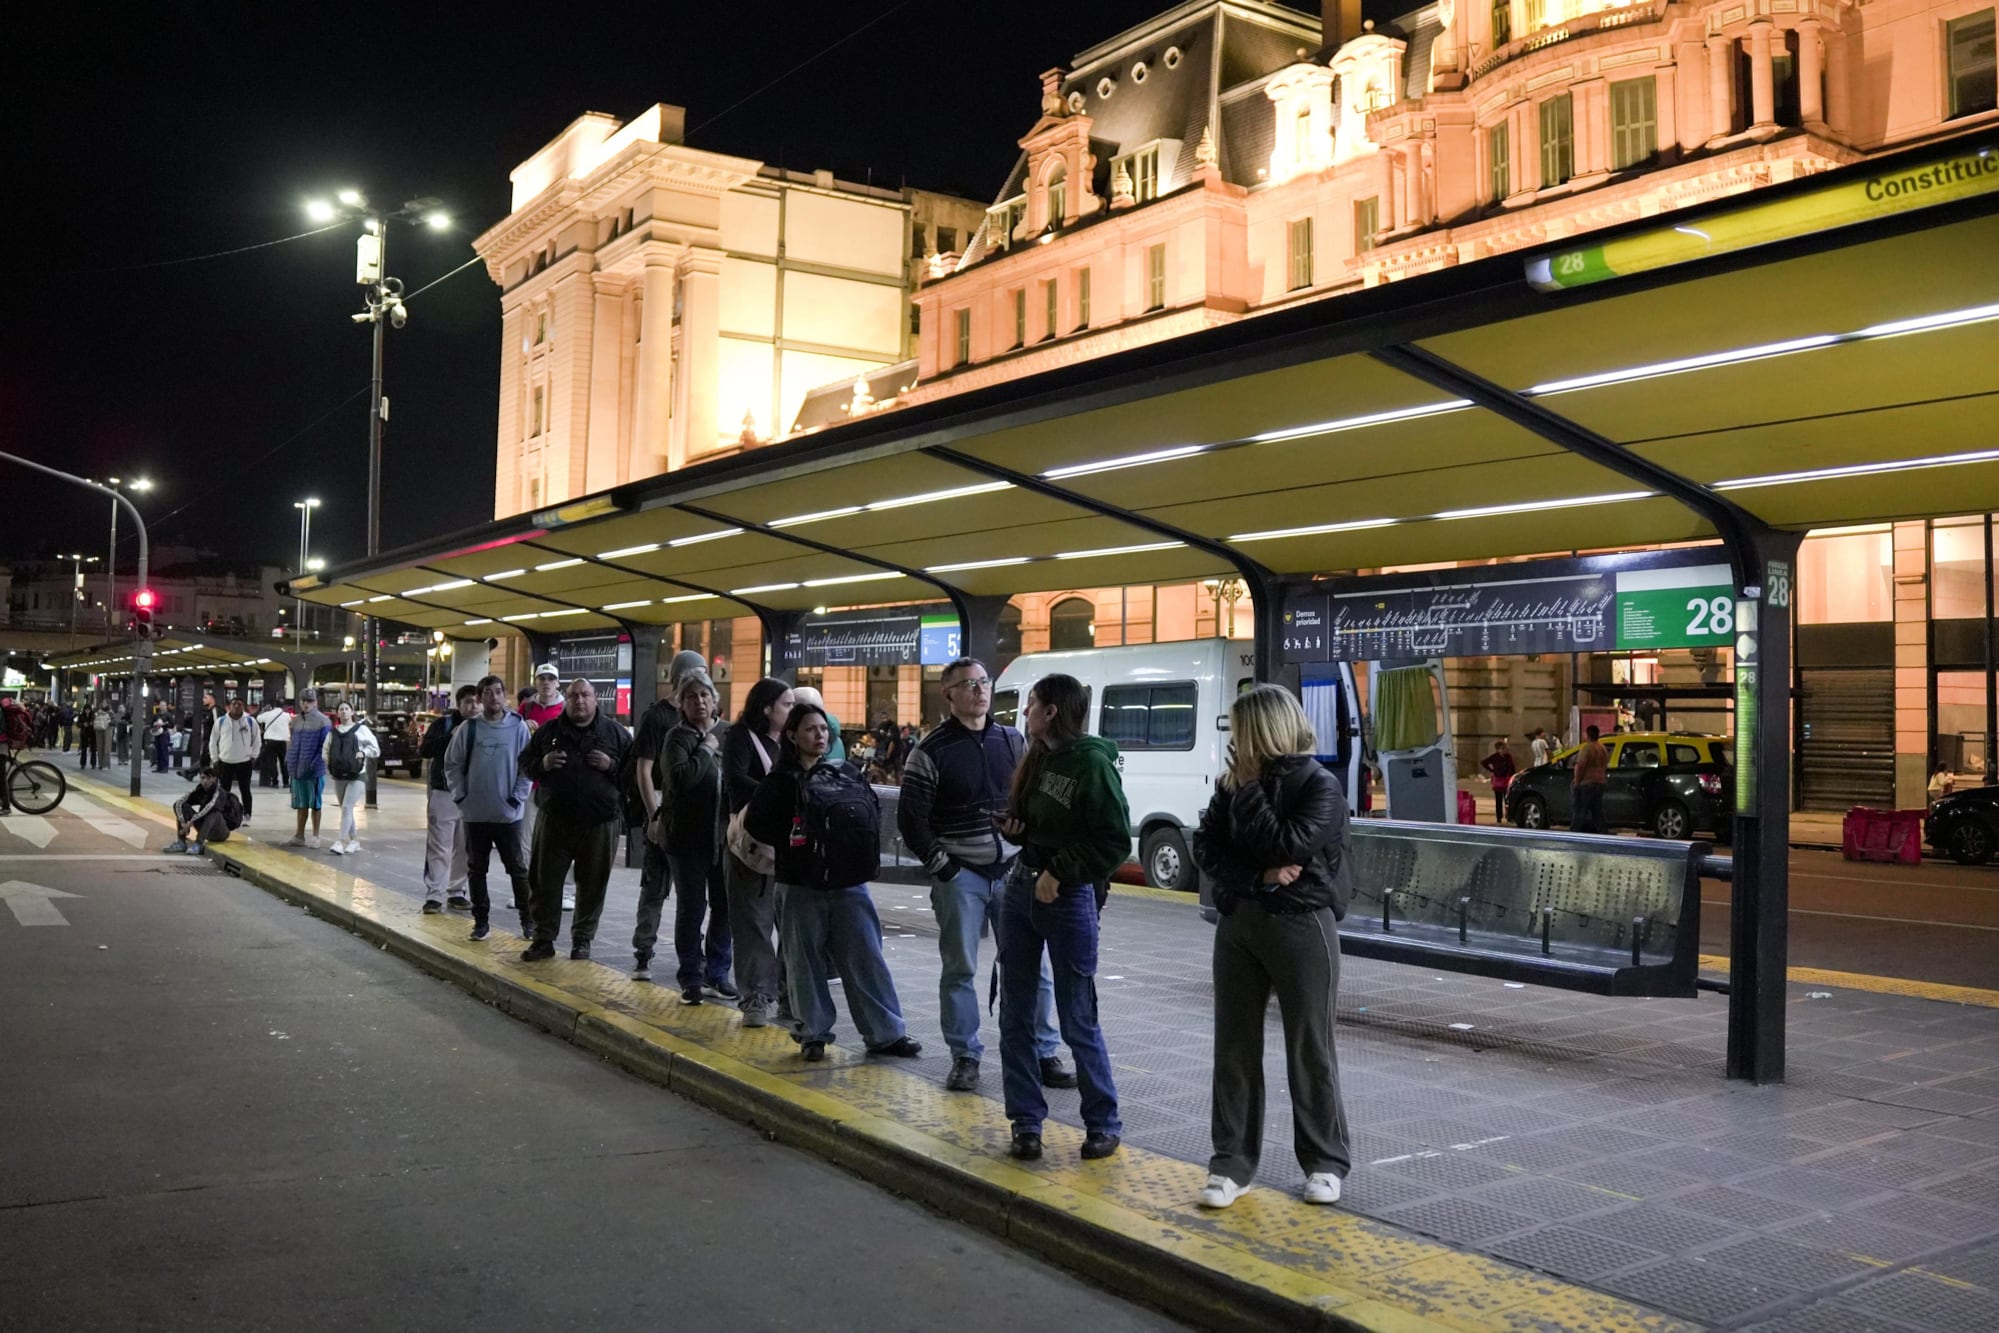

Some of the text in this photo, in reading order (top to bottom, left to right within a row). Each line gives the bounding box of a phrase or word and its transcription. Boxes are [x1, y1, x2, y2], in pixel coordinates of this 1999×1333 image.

[1559, 250, 1585, 275] 28
[1768, 576, 1788, 606] 28
[1296, 618, 1320, 627] prioridad
[1686, 596, 1733, 636] 28
[1739, 671, 1756, 684] 28
